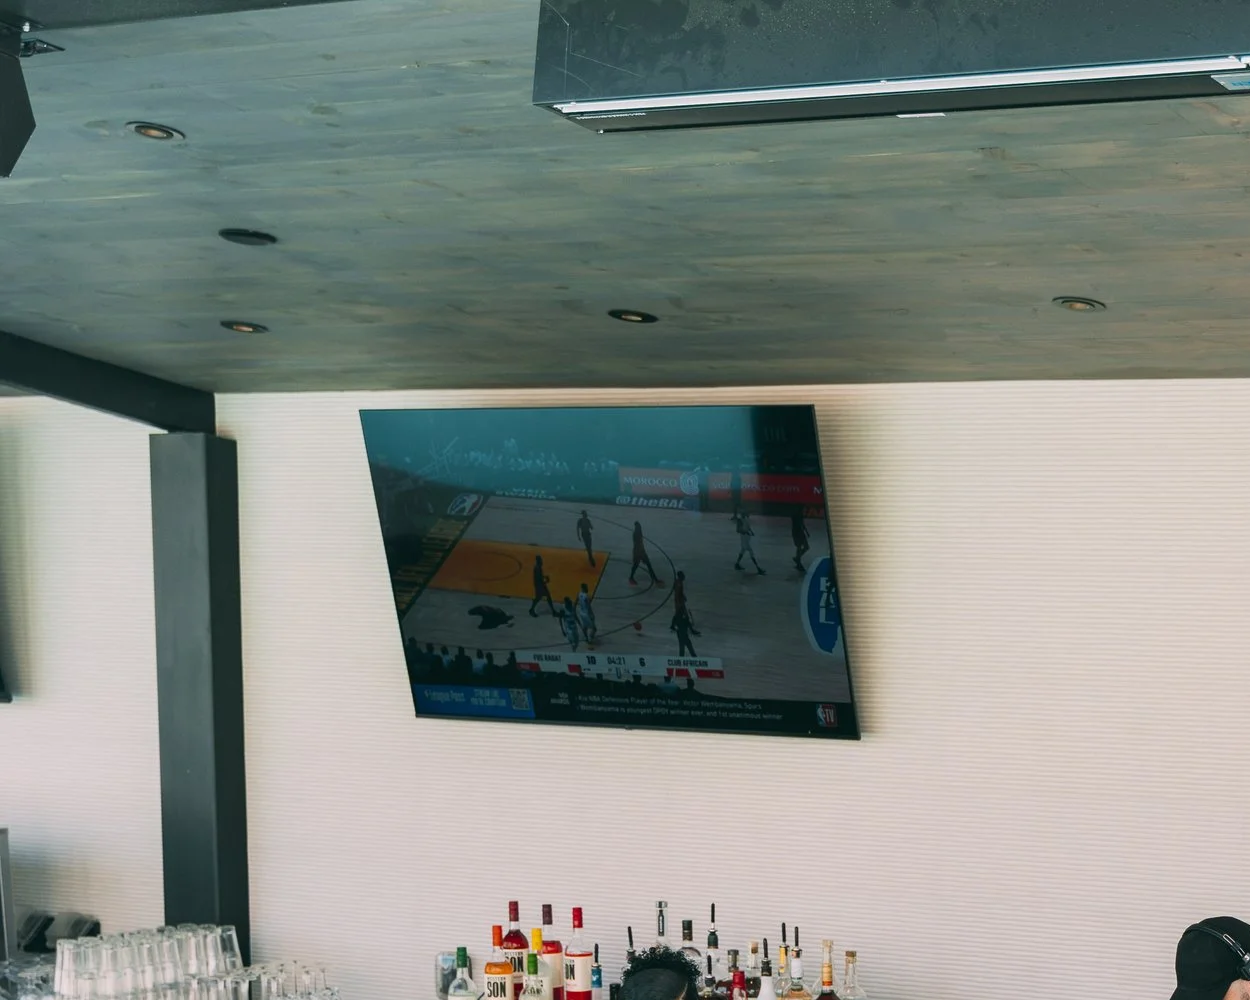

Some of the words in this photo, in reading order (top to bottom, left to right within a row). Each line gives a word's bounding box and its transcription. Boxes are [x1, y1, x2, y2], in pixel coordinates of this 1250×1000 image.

[623, 476, 678, 487] MOROCCO
[586, 656, 597, 665] 10
[606, 656, 626, 665] 04:21
[639, 657, 646, 667] 6
[487, 981, 506, 998] SON
